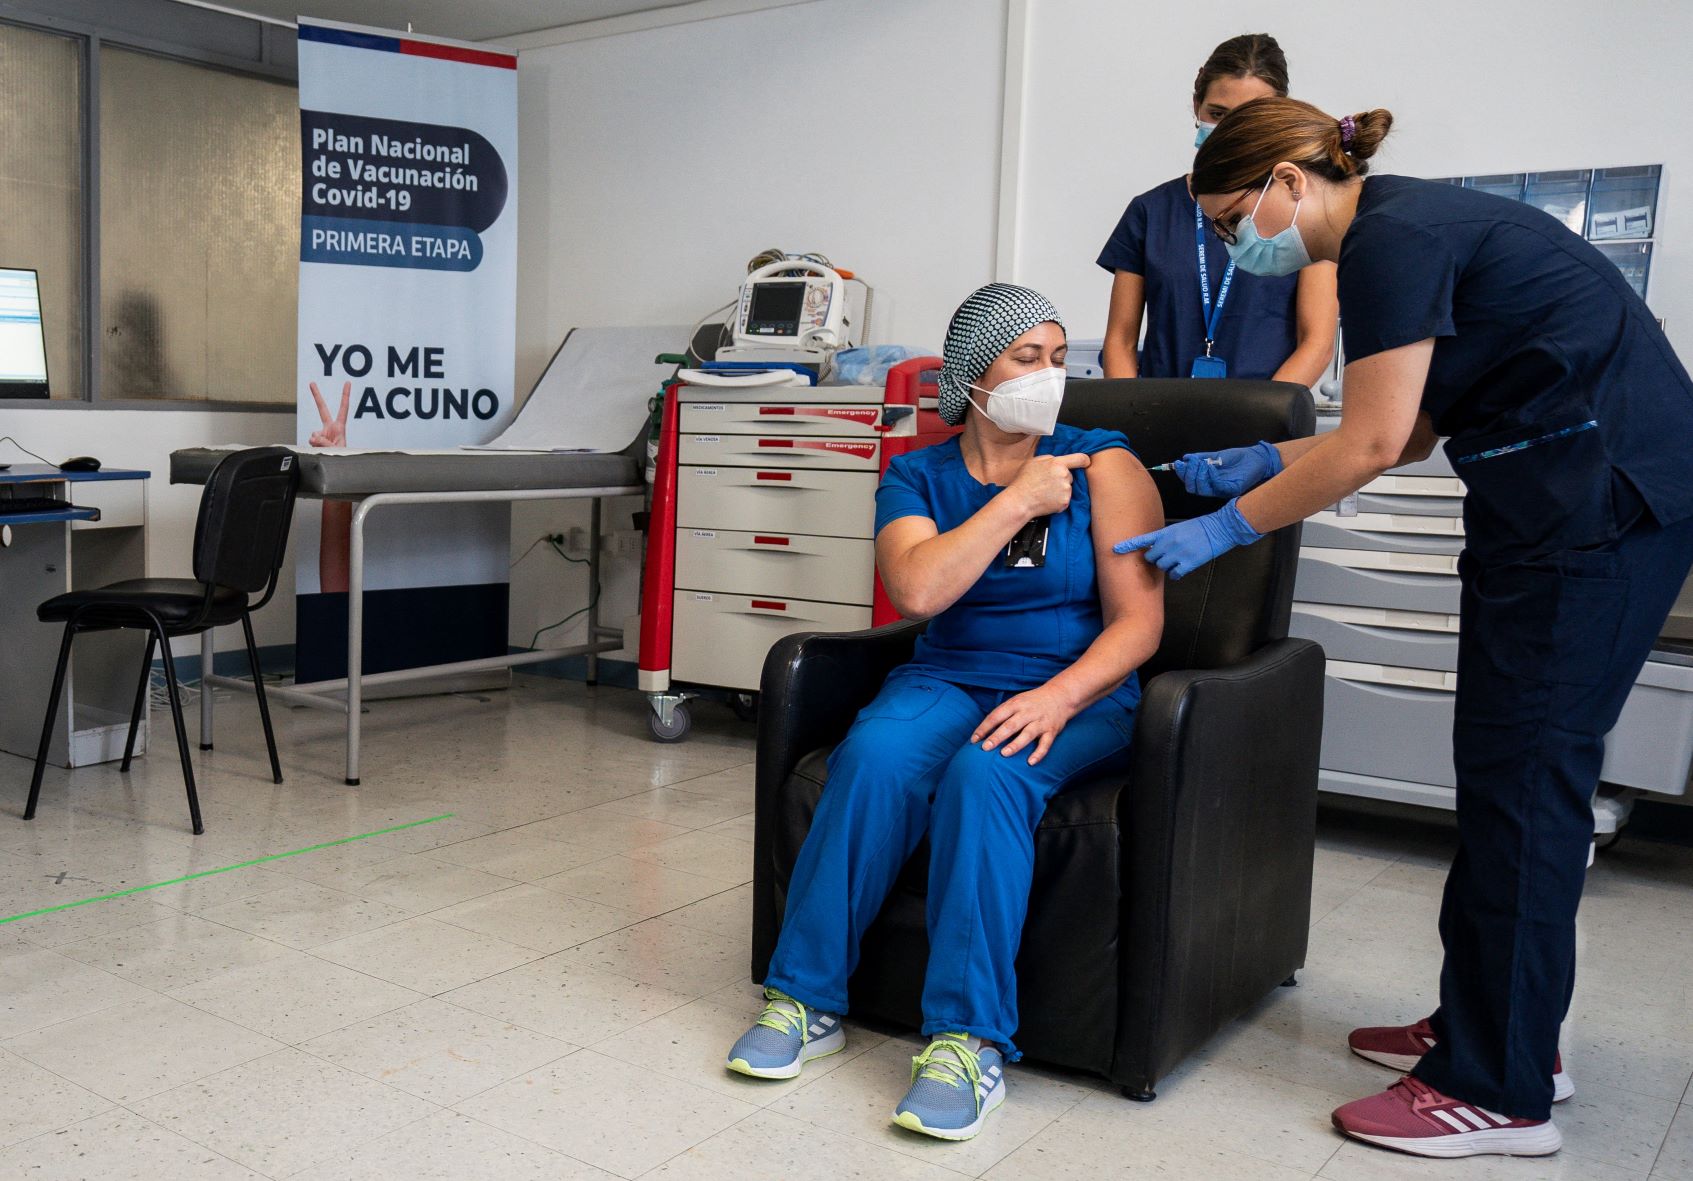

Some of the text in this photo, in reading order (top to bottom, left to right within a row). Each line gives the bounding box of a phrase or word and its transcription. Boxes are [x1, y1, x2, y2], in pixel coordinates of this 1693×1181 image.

[313, 128, 469, 165] Plan Nacional
[312, 154, 478, 192] de Vacunación
[312, 182, 411, 211] Covid-19
[312, 229, 472, 260] PRIMERA ETAPA
[1223, 276, 1232, 286] DE
[314, 343, 445, 379] YO ME
[825, 442, 874, 450] Emergency
